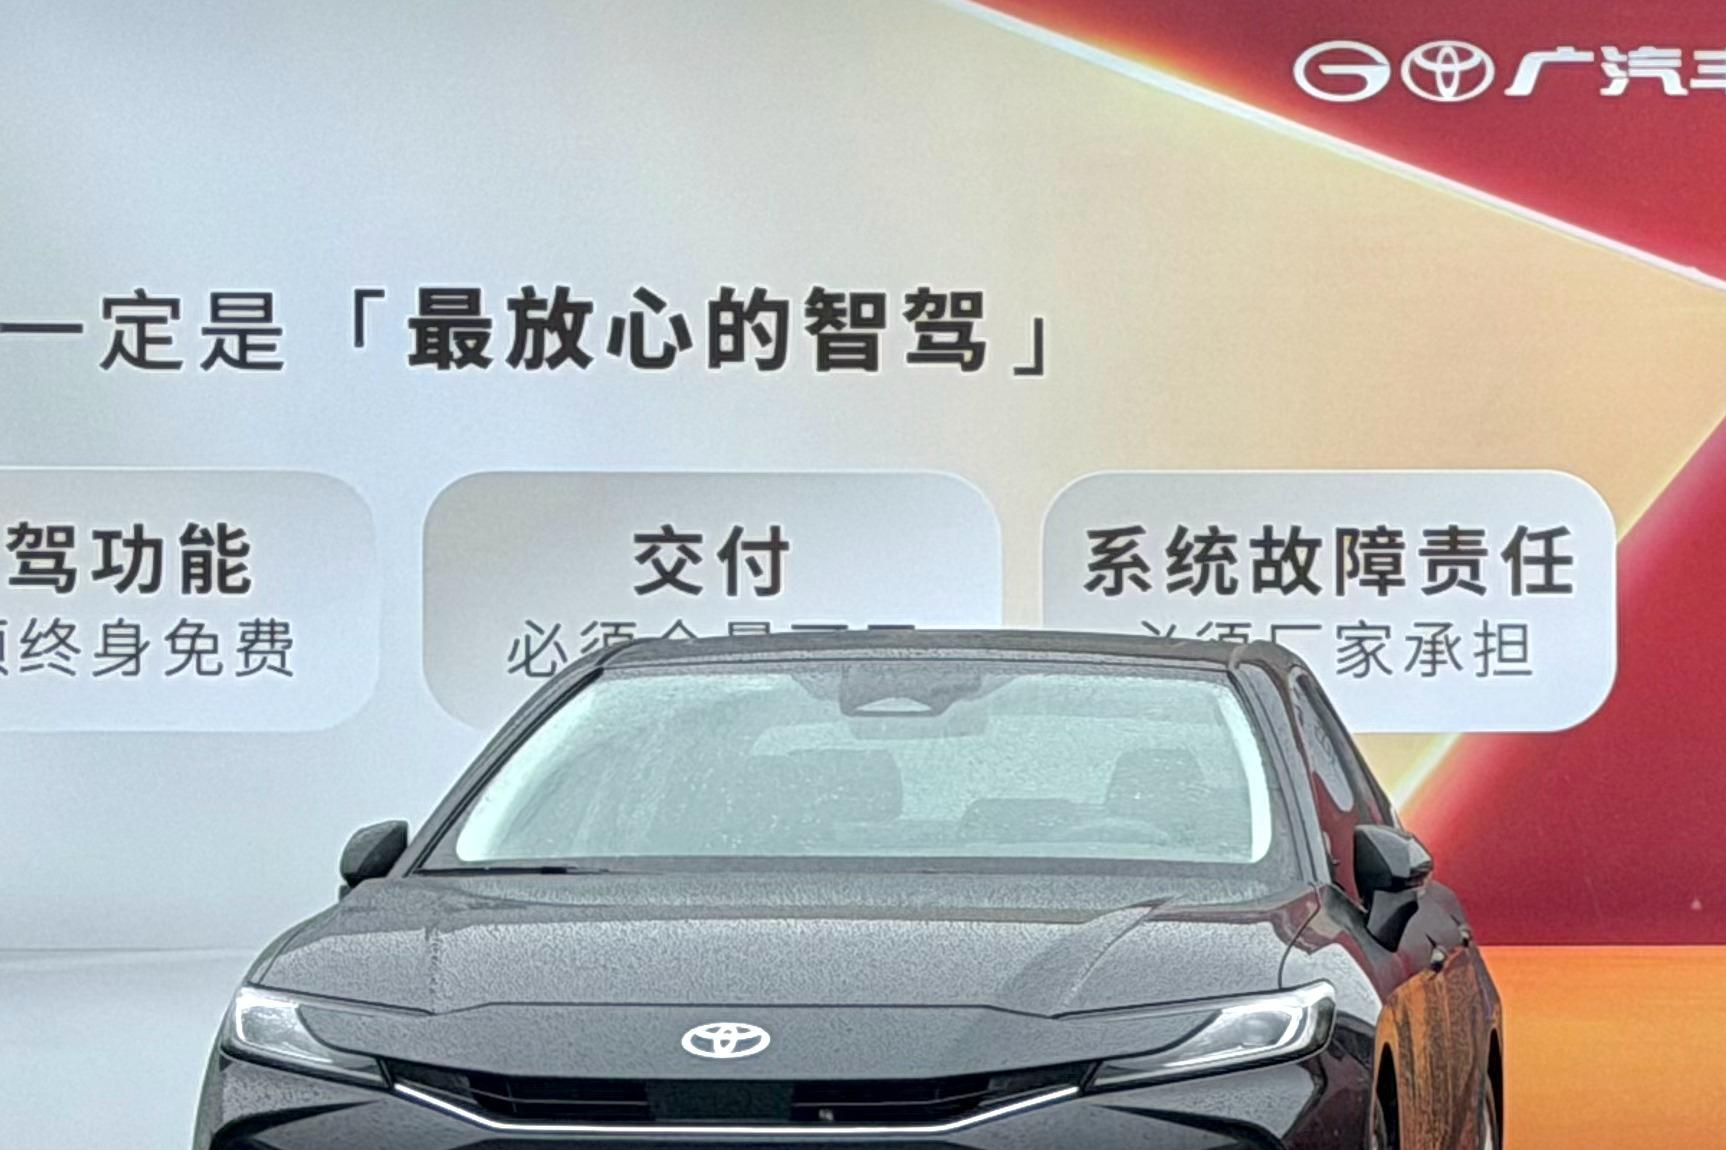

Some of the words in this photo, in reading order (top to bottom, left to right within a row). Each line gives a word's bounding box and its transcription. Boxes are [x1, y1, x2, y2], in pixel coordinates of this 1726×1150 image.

[6, 521, 251, 595] 驾功能
[632, 523, 792, 597] 交付
[1083, 523, 1576, 597] 系统故障责任
[0, 617, 294, 677] 终身免费
